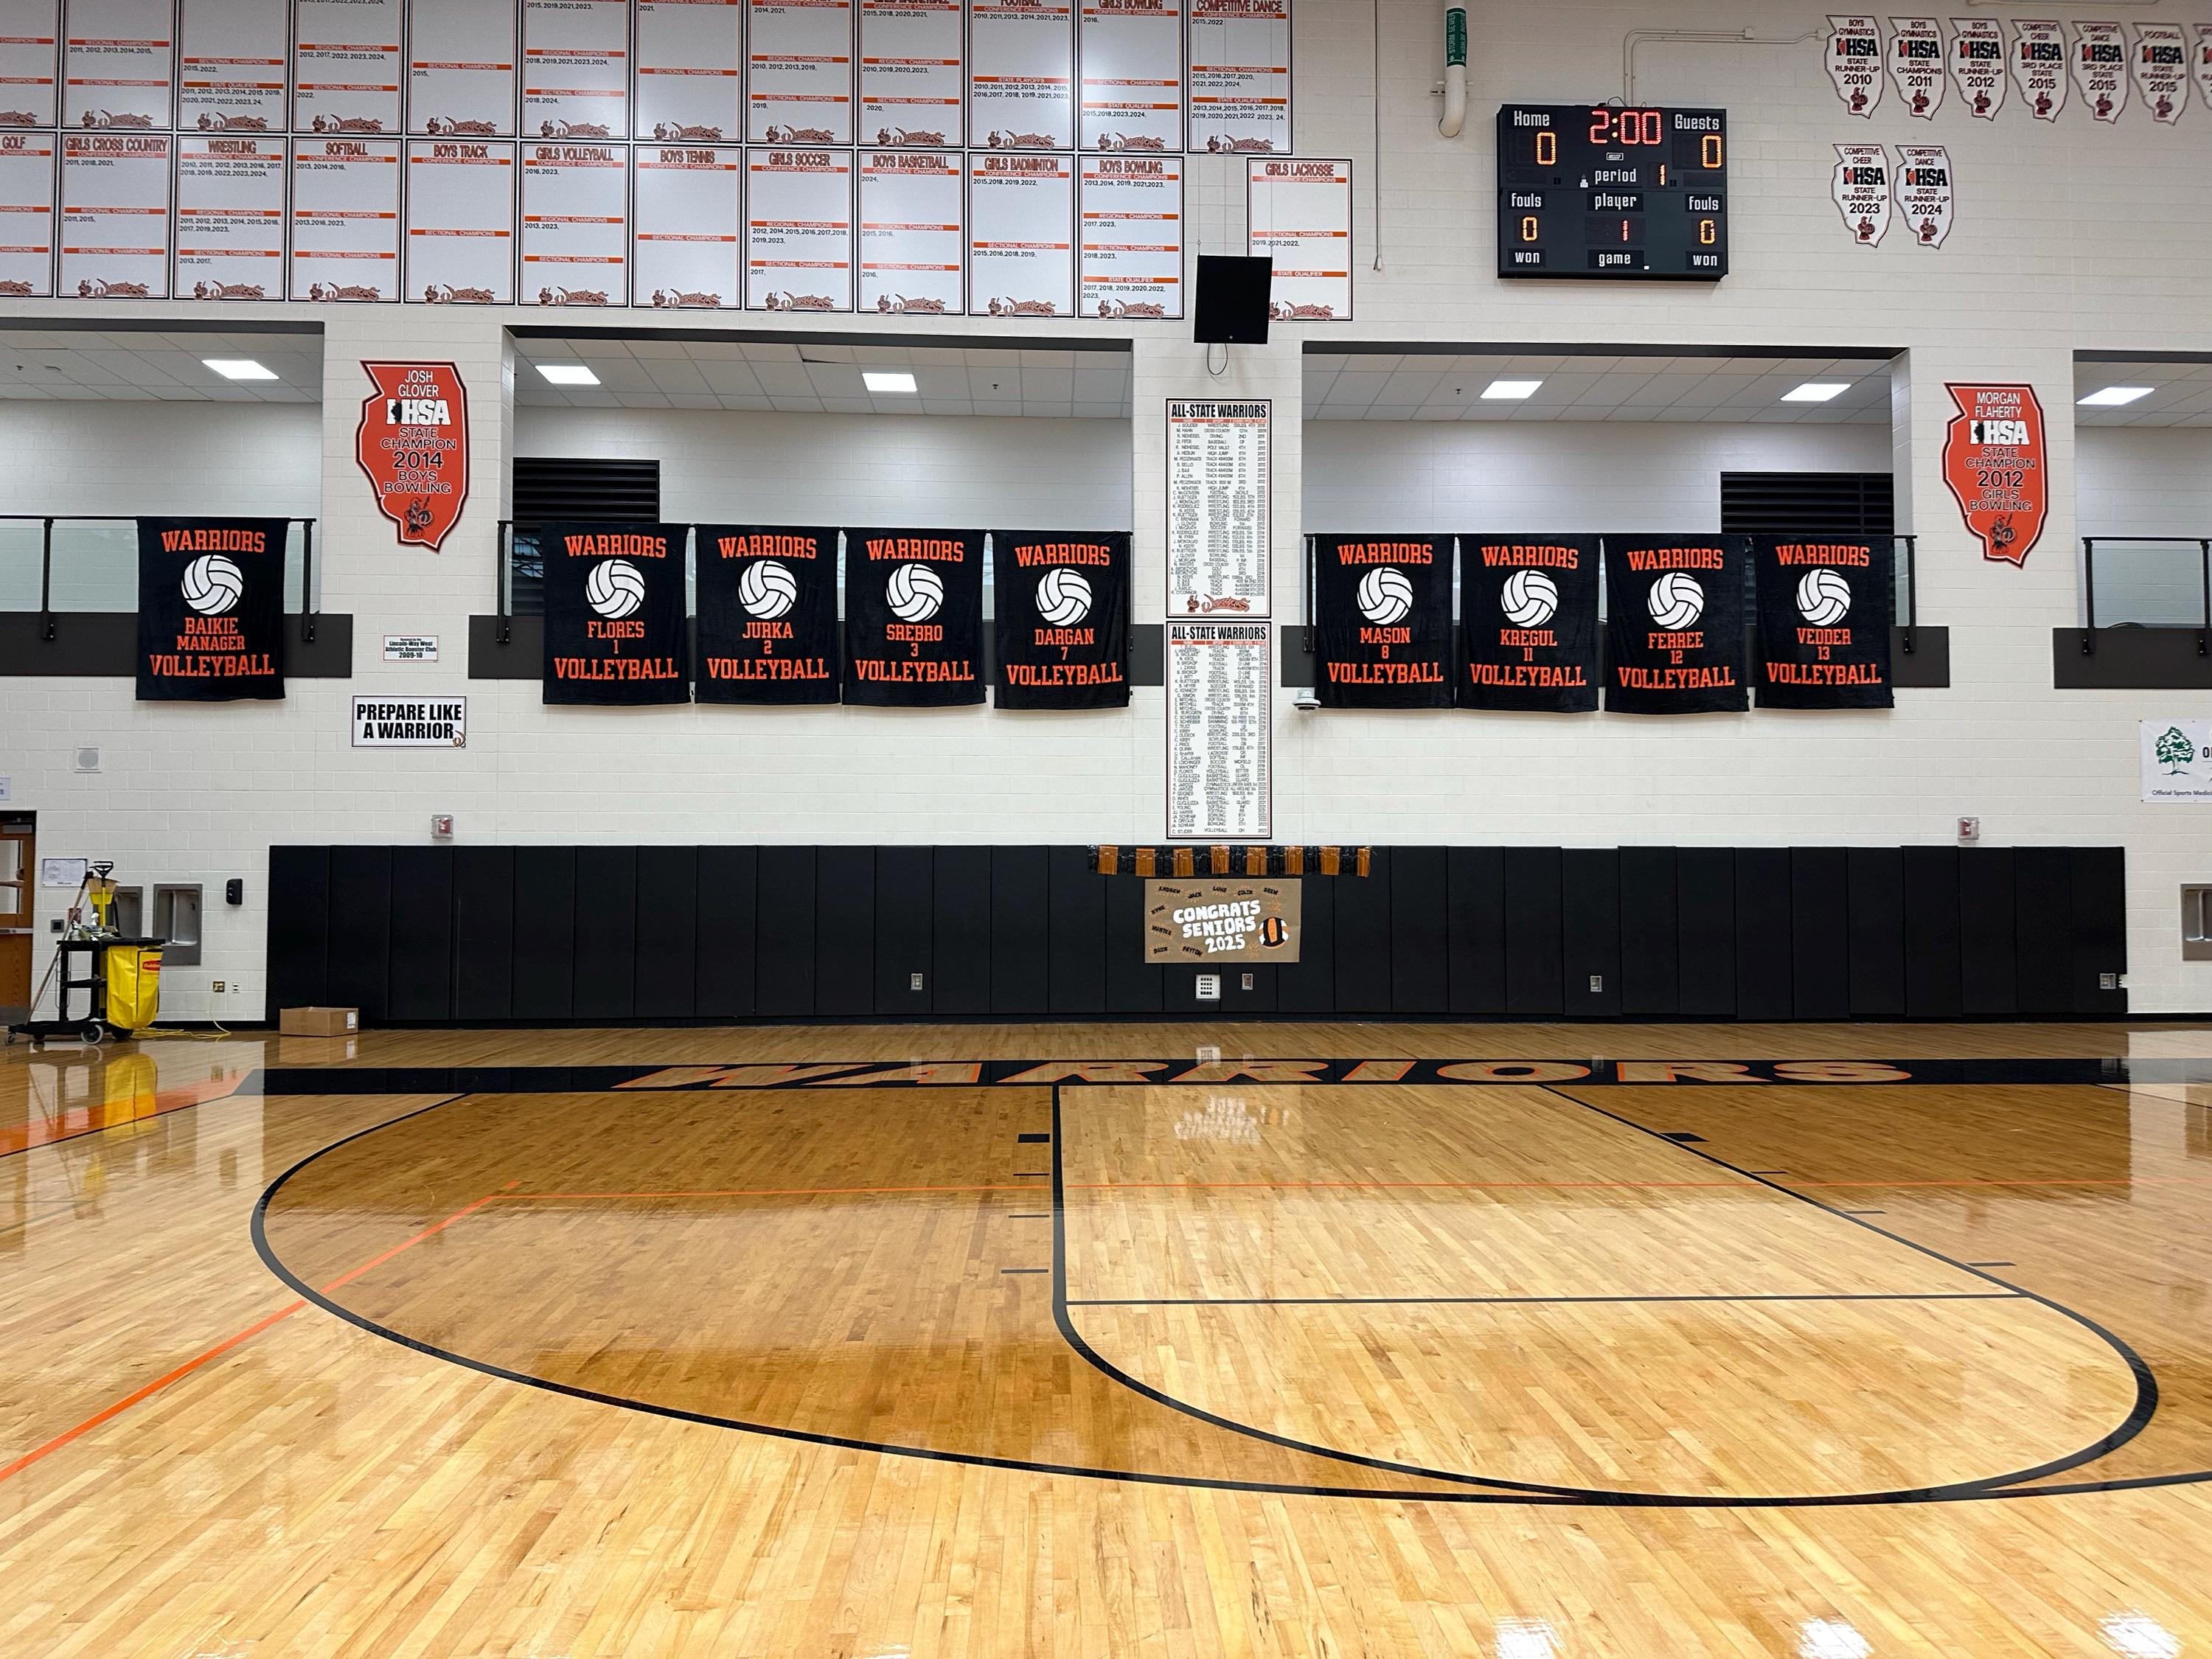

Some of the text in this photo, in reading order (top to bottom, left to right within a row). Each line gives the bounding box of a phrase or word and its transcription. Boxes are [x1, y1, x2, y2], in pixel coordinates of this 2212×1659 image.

[1197, 0, 1282, 13] COMPETITIVE DANCE
[1844, 74, 1871, 85] 2010
[1907, 76, 1932, 86] 2011
[1514, 111, 1550, 126] Home
[1674, 114, 1719, 131] Guests
[1590, 111, 1662, 144] 2:00
[2, 136, 25, 148] GOLF
[66, 137, 167, 151] GIRLS CROSS COUNTRY
[208, 140, 257, 153] WRESTLING
[326, 142, 367, 156] SOFTBALL
[1537, 132, 1556, 164] 0
[434, 145, 489, 159] BOYS TRACK
[536, 147, 613, 161] GIRLS VOLLEYBALL
[661, 150, 714, 164] BOYS TENNIS
[1702, 135, 1722, 168] 0
[768, 153, 830, 166] GIRLS SOCCER
[872, 156, 948, 169] BOYS BASKETBALL
[984, 158, 1058, 171] GIRLS BADMINTON
[1099, 160, 1162, 173] BOYS BOWLING
[1265, 162, 1334, 176] GIRLS LACROSSE
[1595, 168, 1636, 185] period
[1660, 164, 1666, 186] 1
[1512, 193, 1542, 207] fouls
[1595, 193, 1637, 209] player
[1689, 196, 1719, 211] fouls
[1849, 204, 1880, 214] 2023
[1912, 204, 1942, 215] 2024
[1523, 217, 1537, 241] 0
[1622, 220, 1628, 241] 1
[1515, 251, 1540, 264] won
[1599, 253, 1631, 267] game
[1693, 254, 1718, 267] won
[405, 371, 433, 383] JOSH
[398, 384, 439, 397] GLOVER
[1977, 392, 2020, 405] MORGAN
[1172, 404, 1266, 417] ALL-STATE WARRIORS
[1975, 406, 2022, 417] FLAHERTY
[400, 428, 438, 438] STATE
[380, 439, 456, 450] CHAMPION
[392, 451, 443, 469] 2014
[1983, 448, 2017, 457] STATE
[1965, 458, 2035, 468] CHAMPION
[398, 471, 437, 481] BOYS
[1977, 470, 2023, 487] 2012
[384, 483, 451, 493] BOWLING
[1983, 489, 2019, 499] GIRLS
[1969, 501, 2031, 511] BOWLING
[161, 529, 265, 553] WARRIORS
[564, 535, 667, 558] WARRIORS
[718, 535, 817, 560] WARRIORS
[866, 539, 964, 563] WARRIORS
[1015, 543, 1110, 567] WARRIORS
[1338, 543, 1433, 565] WARRIORS
[1481, 546, 1579, 569] WARRIORS
[1776, 545, 1870, 566] WARRIORS
[1627, 549, 1723, 571] WARRIORS
[184, 617, 238, 635] BAIKIE
[588, 621, 644, 639] FLORES
[742, 622, 793, 639] JURKA
[887, 625, 943, 641] SREBRO
[1172, 627, 1266, 639] ALL-STATE WARRIORS
[1035, 629, 1094, 645] DARGAN
[1360, 627, 1411, 644] MASON
[1500, 630, 1557, 647] KREGUL
[1648, 632, 1704, 649] FERREE
[1797, 628, 1851, 644] VEDDER
[177, 636, 246, 651] MANAGER
[613, 640, 619, 654] 1
[764, 640, 772, 655] 2
[911, 643, 918, 656] 3
[1061, 647, 1068, 660] 7
[1382, 645, 1388, 659] 8
[1524, 648, 1534, 661] 11
[1671, 650, 1683, 664] 12
[1818, 647, 1829, 660] 13
[150, 655, 274, 676] VOLLEYBALL
[554, 658, 678, 680] VOLLEYBALL
[707, 658, 829, 680] VOLLEYBALL
[855, 660, 974, 682] VOLLEYBALL
[1328, 662, 1444, 684] VOLLEYBALL
[1006, 662, 1123, 686] VOLLEYBALL
[1470, 664, 1587, 686] VOLLEYBALL
[1618, 667, 1735, 689] VOLLEYBALL
[1767, 662, 1882, 685] VOLLEYBALL
[357, 704, 462, 720] PREPARE LIKE
[363, 722, 453, 740] A WARRIOR
[1173, 900, 1261, 923] CONGRATS
[1183, 916, 1256, 938] SENIORS
[1183, 946, 1203, 956] PAYTON
[1205, 934, 1245, 953] 2025
[611, 1060, 1913, 1089] WARRIORS
